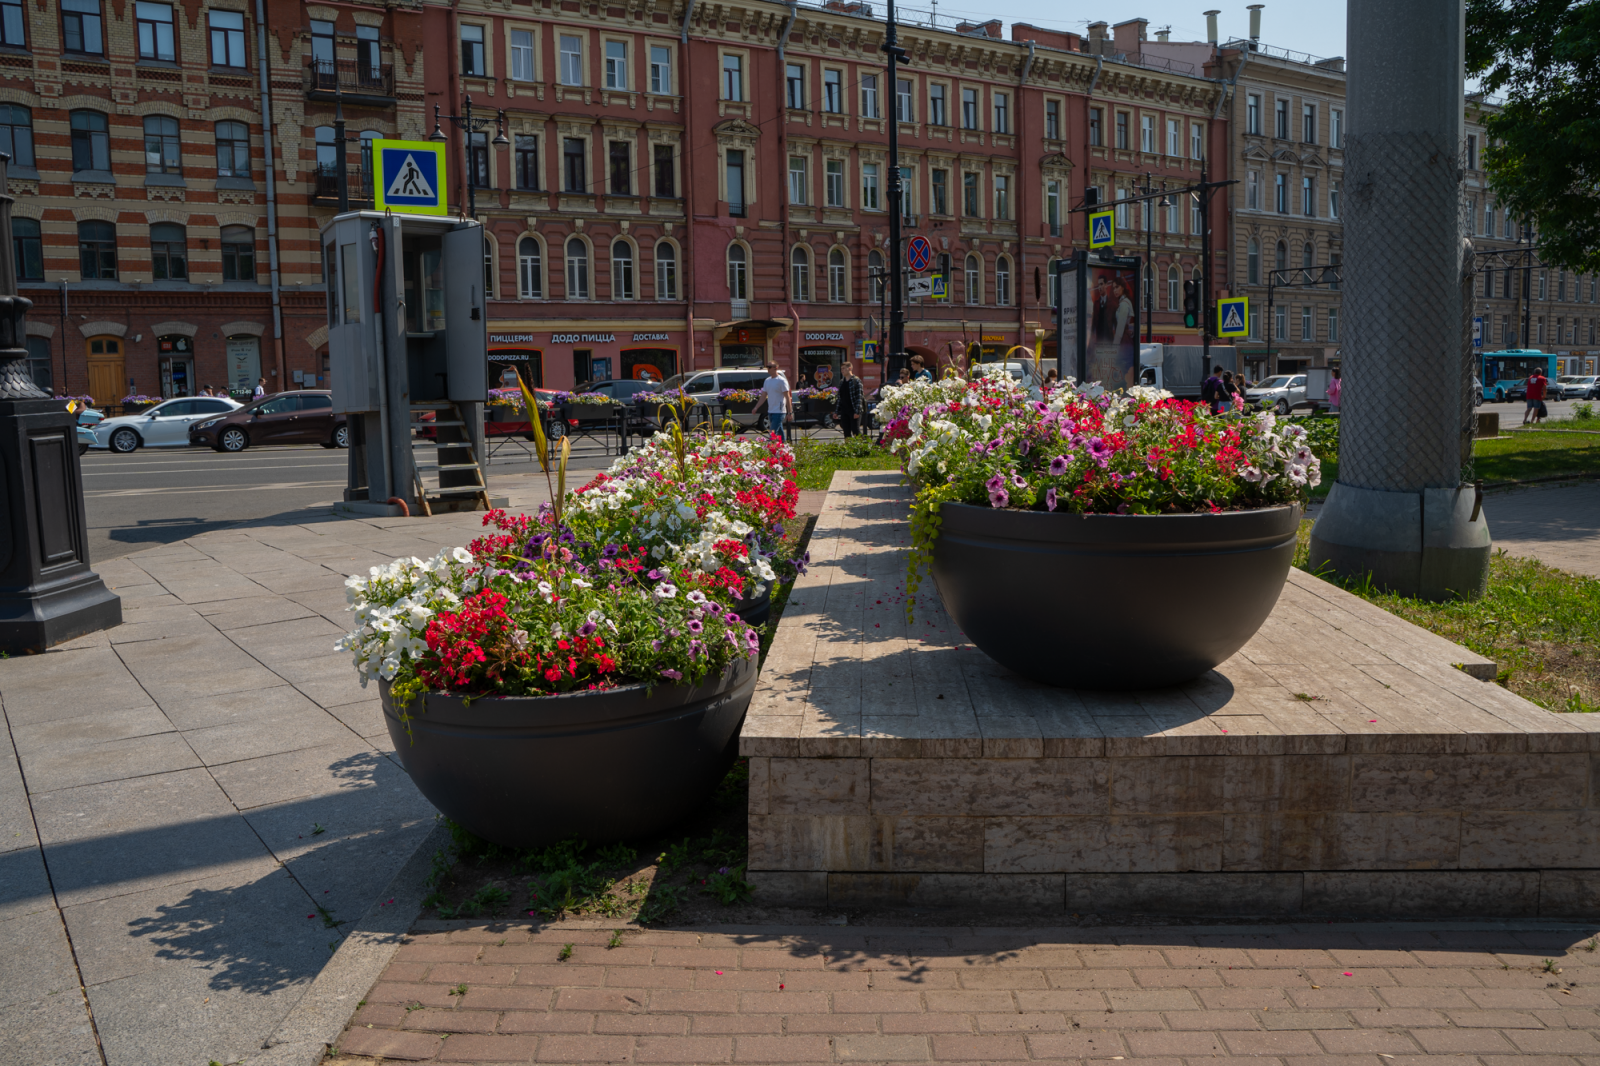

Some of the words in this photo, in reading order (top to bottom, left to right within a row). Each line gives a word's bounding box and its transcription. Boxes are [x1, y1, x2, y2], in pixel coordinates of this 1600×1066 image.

[490, 335, 533, 343] ПИЦЦЕРИЯ
[551, 334, 580, 344] ДОДО
[581, 334, 616, 344] ПИЦЦА
[632, 333, 669, 342] ДОСТАВКА
